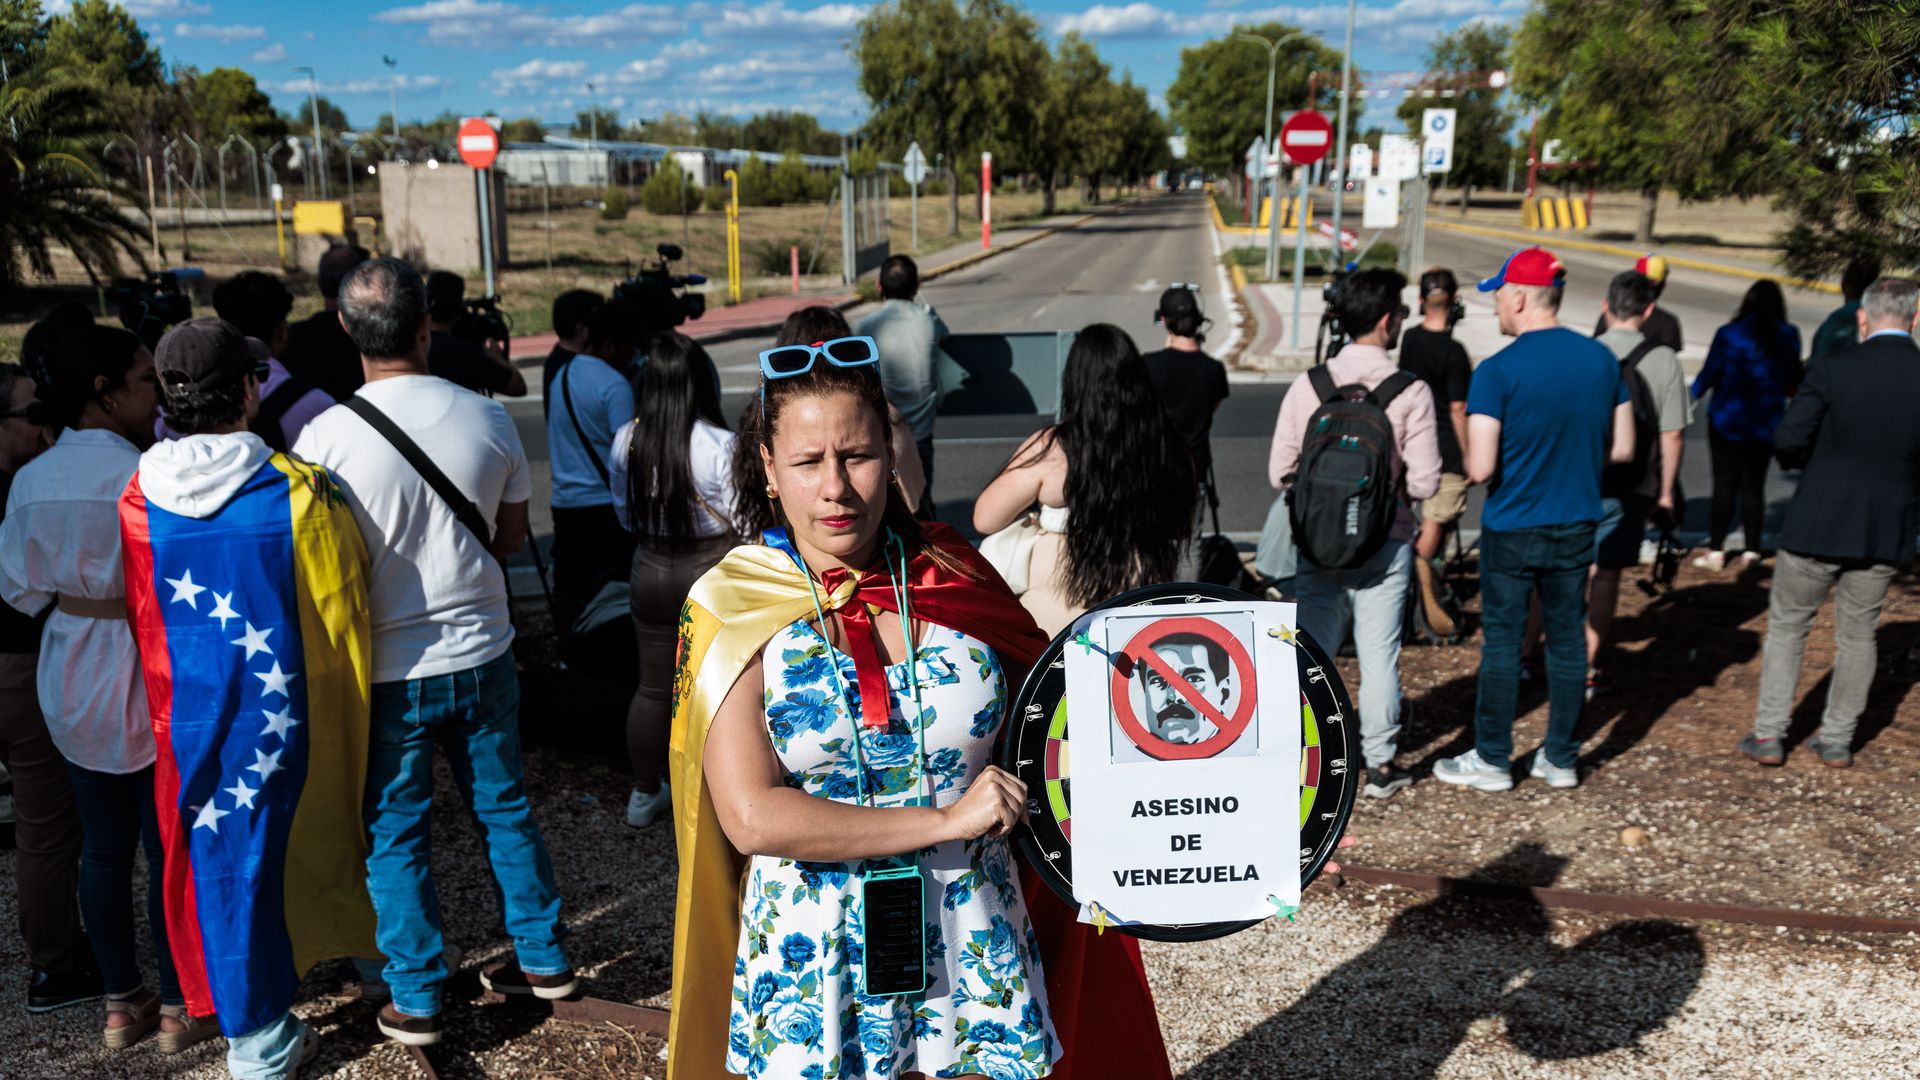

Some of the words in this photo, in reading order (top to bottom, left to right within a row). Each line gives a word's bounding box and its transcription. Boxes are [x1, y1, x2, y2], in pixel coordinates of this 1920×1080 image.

[1345, 496, 1360, 535] THULE
[1131, 796, 1239, 818] ASESINO
[1171, 834, 1202, 852] DE
[1113, 864, 1260, 887] VENEZUELA
